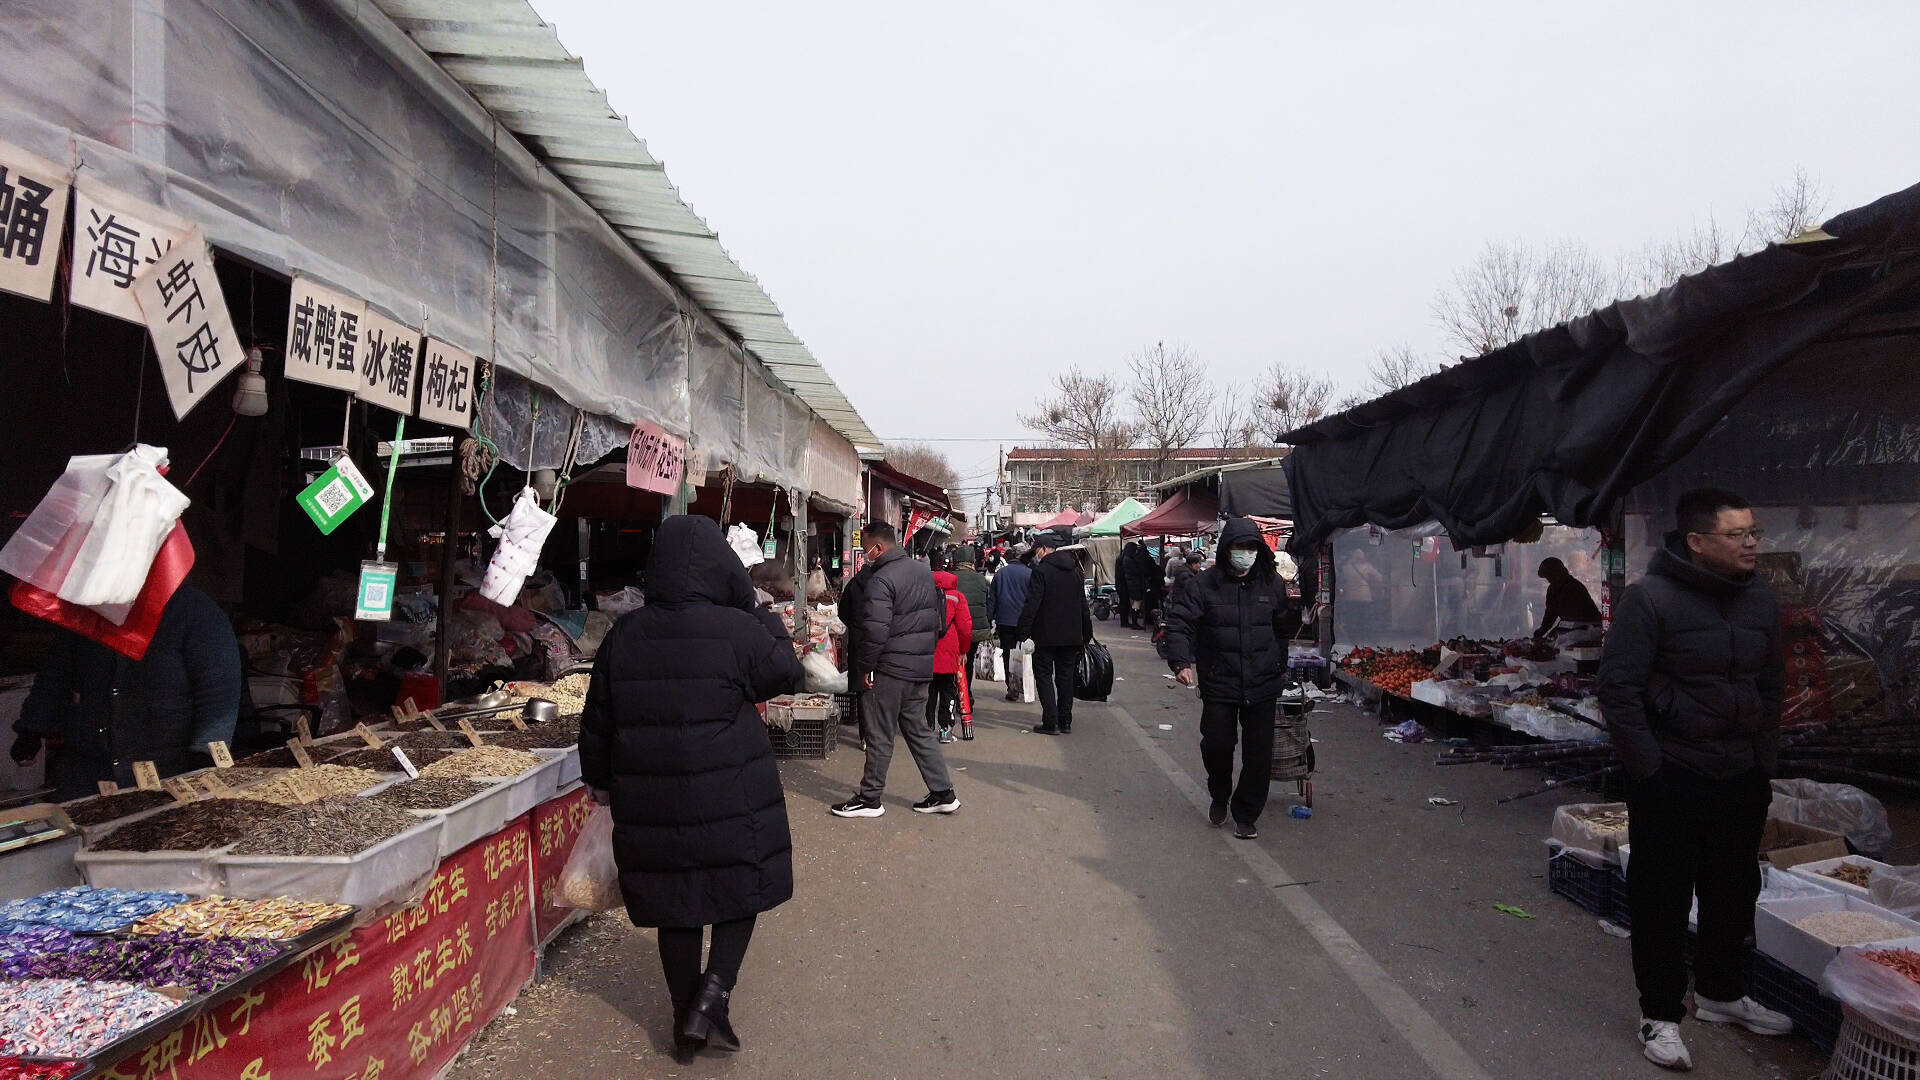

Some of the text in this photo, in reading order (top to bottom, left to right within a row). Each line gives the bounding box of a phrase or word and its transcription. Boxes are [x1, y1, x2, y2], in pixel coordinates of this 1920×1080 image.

[156, 259, 222, 394] 虾皮
[290, 296, 359, 375] 咸鸭蛋
[362, 328, 414, 399] 冰糖
[426, 352, 469, 413] 枸杞
[92, 992, 266, 1080] 种瓜子
[307, 994, 364, 1072] 蚕豆
[390, 921, 473, 1011] 熟花生米
[407, 972, 484, 1067] 各种坚果
